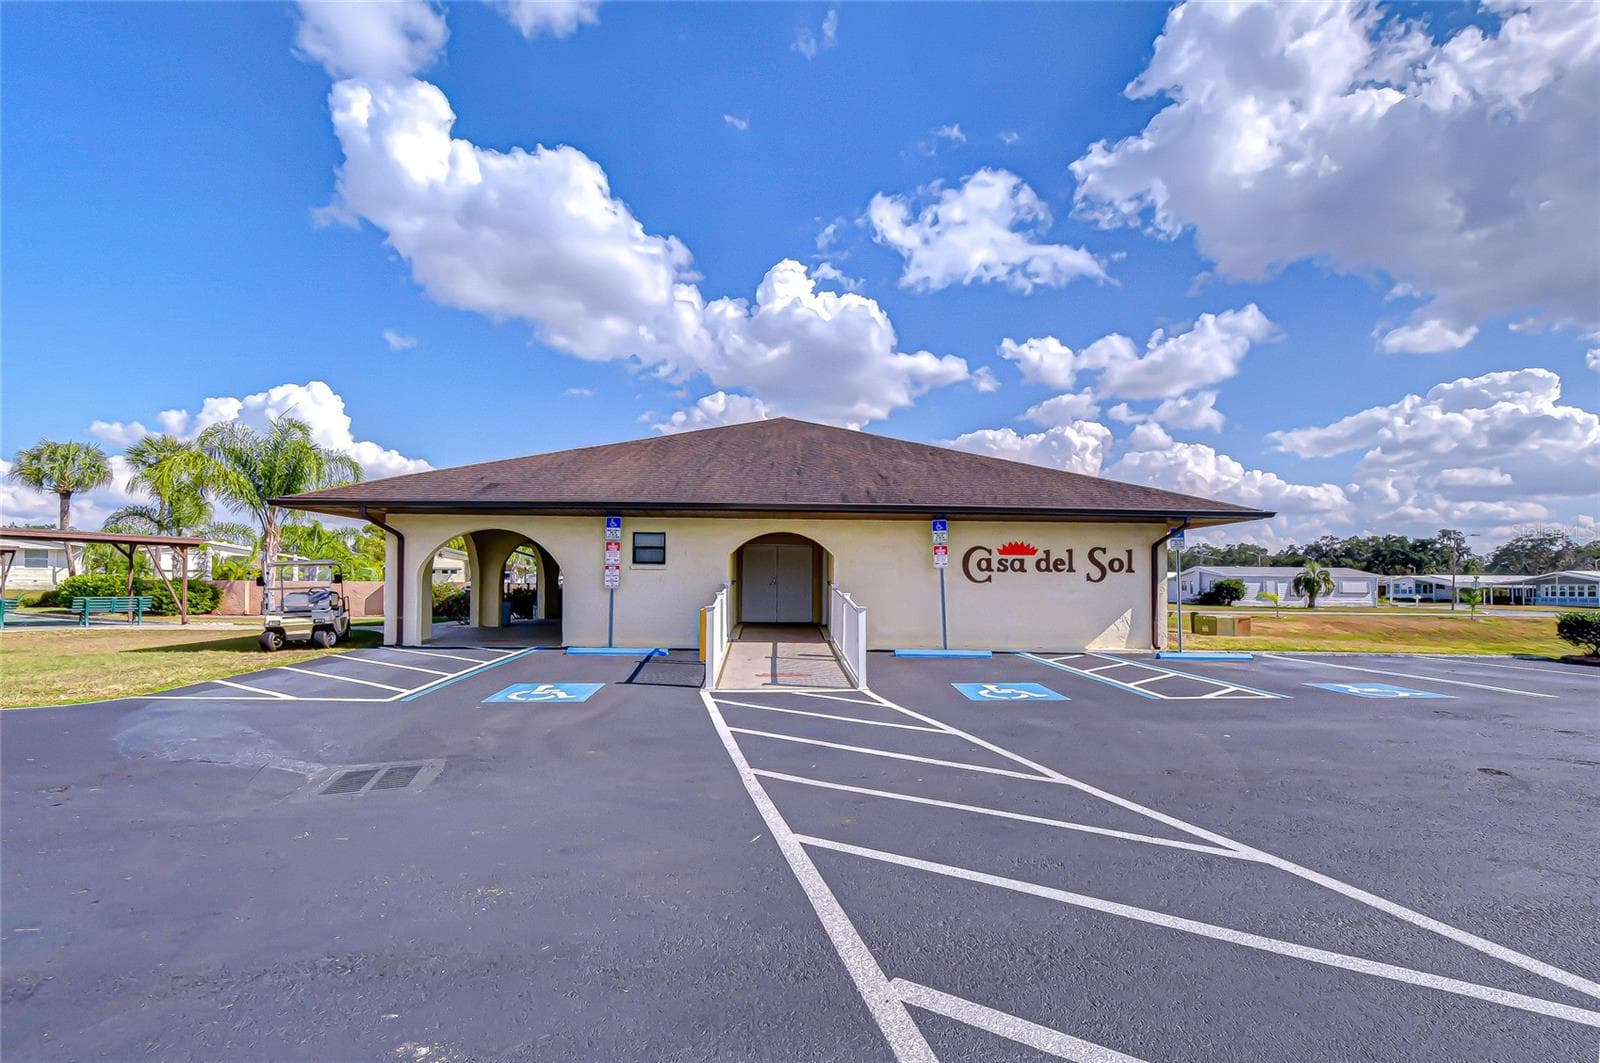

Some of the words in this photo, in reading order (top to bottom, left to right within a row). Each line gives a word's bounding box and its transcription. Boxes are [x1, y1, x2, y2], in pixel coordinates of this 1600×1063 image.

[962, 545, 1027, 583] Casa
[1035, 549, 1076, 573] del
[1086, 547, 1136, 583] Sol
